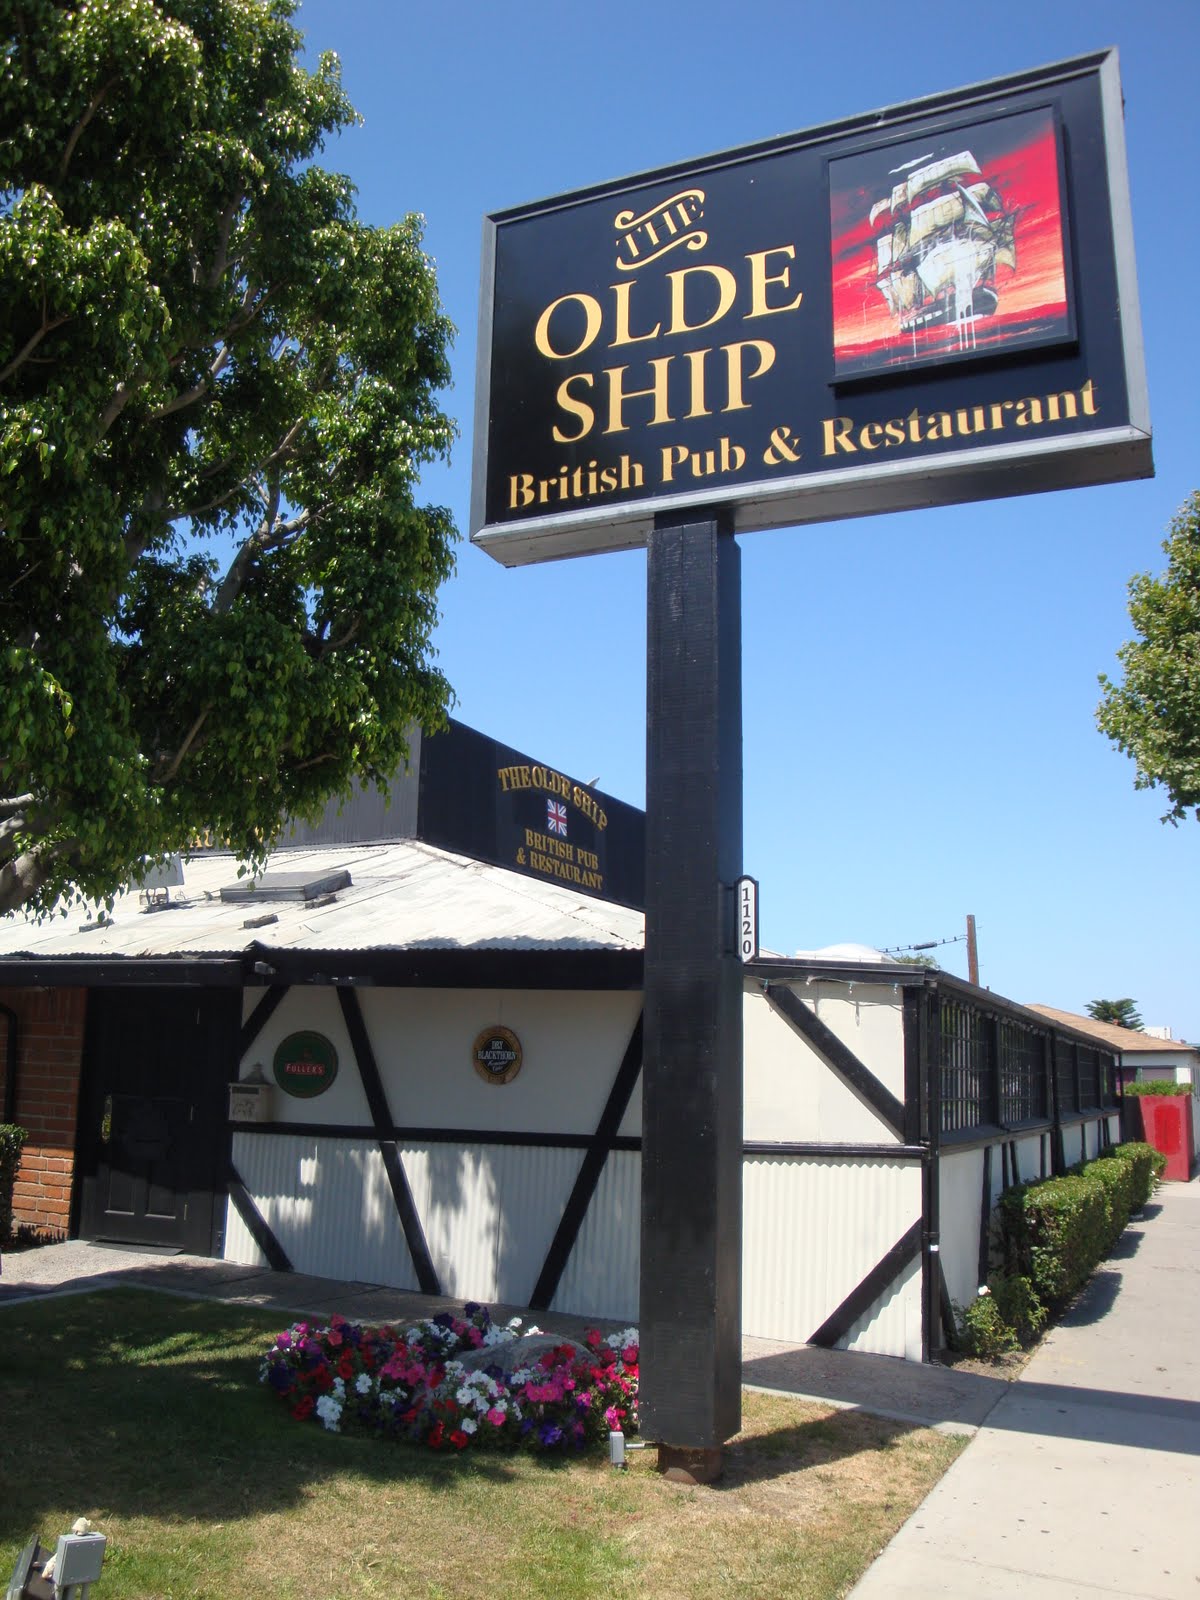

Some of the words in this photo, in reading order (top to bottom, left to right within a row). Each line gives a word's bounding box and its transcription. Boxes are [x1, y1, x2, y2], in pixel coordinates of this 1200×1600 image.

[615, 196, 705, 257] THE
[534, 245, 803, 359] OLDE
[552, 340, 777, 443] SHIP
[509, 454, 644, 509] British
[662, 437, 746, 482] Pub
[762, 425, 801, 465] &
[821, 379, 1100, 456] Restaurant
[498, 765, 532, 792] THE
[532, 766, 570, 800] OLDE
[573, 786, 608, 831] SHIP
[516, 848, 526, 864] &
[530, 851, 602, 890] RESTAURANT
[525, 828, 573, 861] BRITISH
[577, 848, 598, 870] PUB
[742, 887, 752, 954] 1120
[478, 1051, 516, 1059] BLACKTHORN
[492, 1041, 503, 1049] DRY
